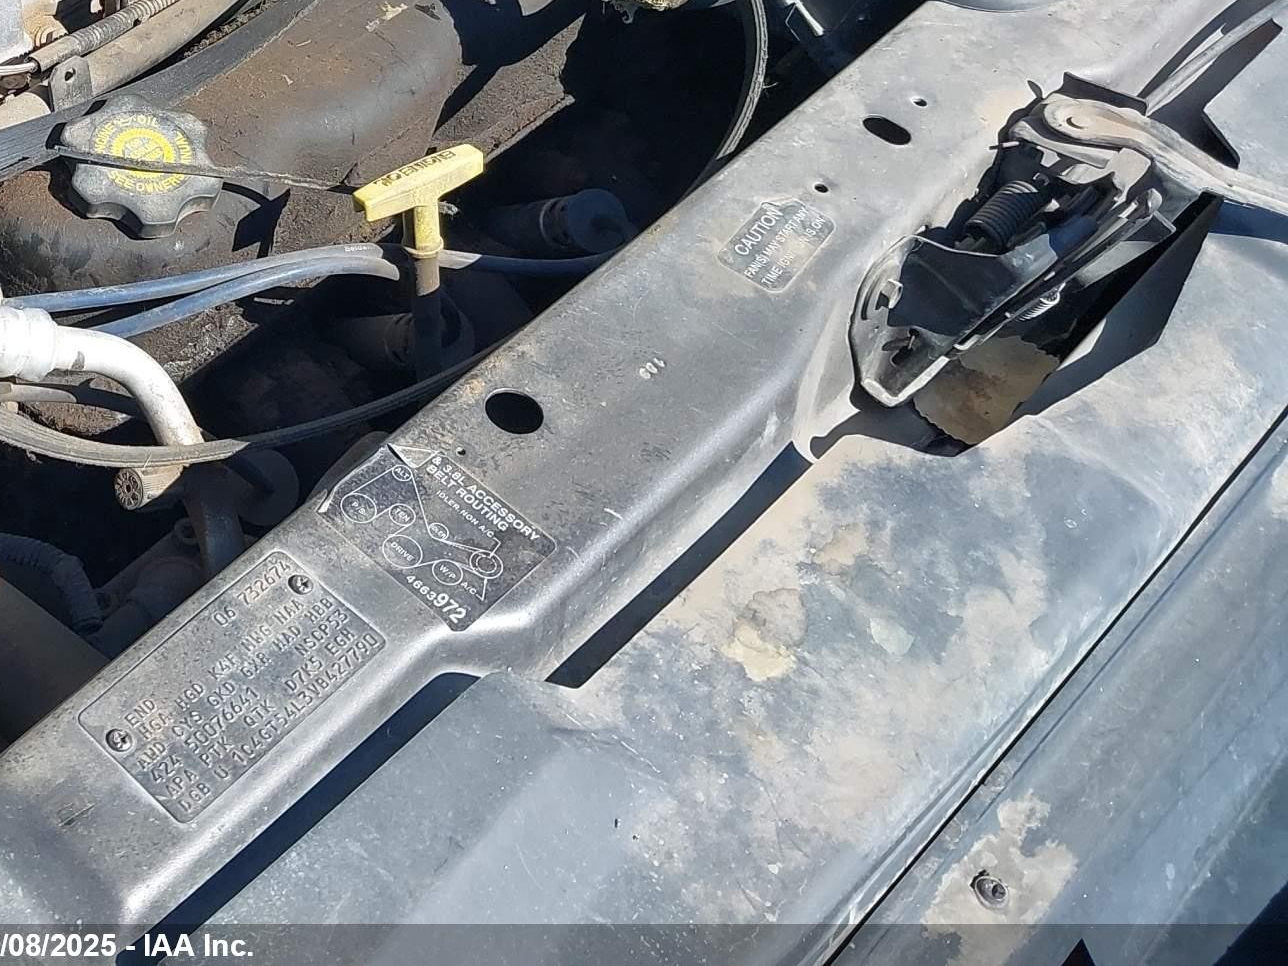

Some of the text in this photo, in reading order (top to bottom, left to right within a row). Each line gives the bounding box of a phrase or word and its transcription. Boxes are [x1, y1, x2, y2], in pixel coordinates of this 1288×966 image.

[94, 121, 114, 153] NGINE
[137, 114, 158, 127] OIL
[107, 170, 135, 188] SEE
[135, 173, 184, 193] OWNERS
[735, 205, 784, 255] CAUTION
[744, 207, 808, 279] FAN(S) MAY START ANY
[761, 266, 782, 286] TIME
[811, 217, 825, 229] ON
[394, 466, 410, 481] ALT
[426, 464, 509, 530] BELT ROUTING
[393, 507, 410, 523] TEN
[442, 465, 466, 485] 3.8L
[466, 484, 539, 541] ACCESSORY
[389, 541, 415, 563] DRIVE
[478, 523, 495, 538] A/C
[238, 558, 290, 605] 732674
[438, 564, 457, 581] W/P
[460, 580, 478, 596] A/C
[406, 574, 466, 623] 4663972
[171, 710, 203, 739] CYS
[207, 681, 236, 708] GKD
[306, 598, 333, 624] HBB
[125, 699, 157, 728] END
[137, 710, 170, 741] HGA
[174, 682, 205, 710] HGD
[208, 653, 237, 681] K4F
[148, 753, 182, 785] 424
[295, 610, 348, 657] NSCP53
[163, 628, 355, 799] APA PTK QTK D7K5 EGH
[177, 781, 211, 813] DGB
